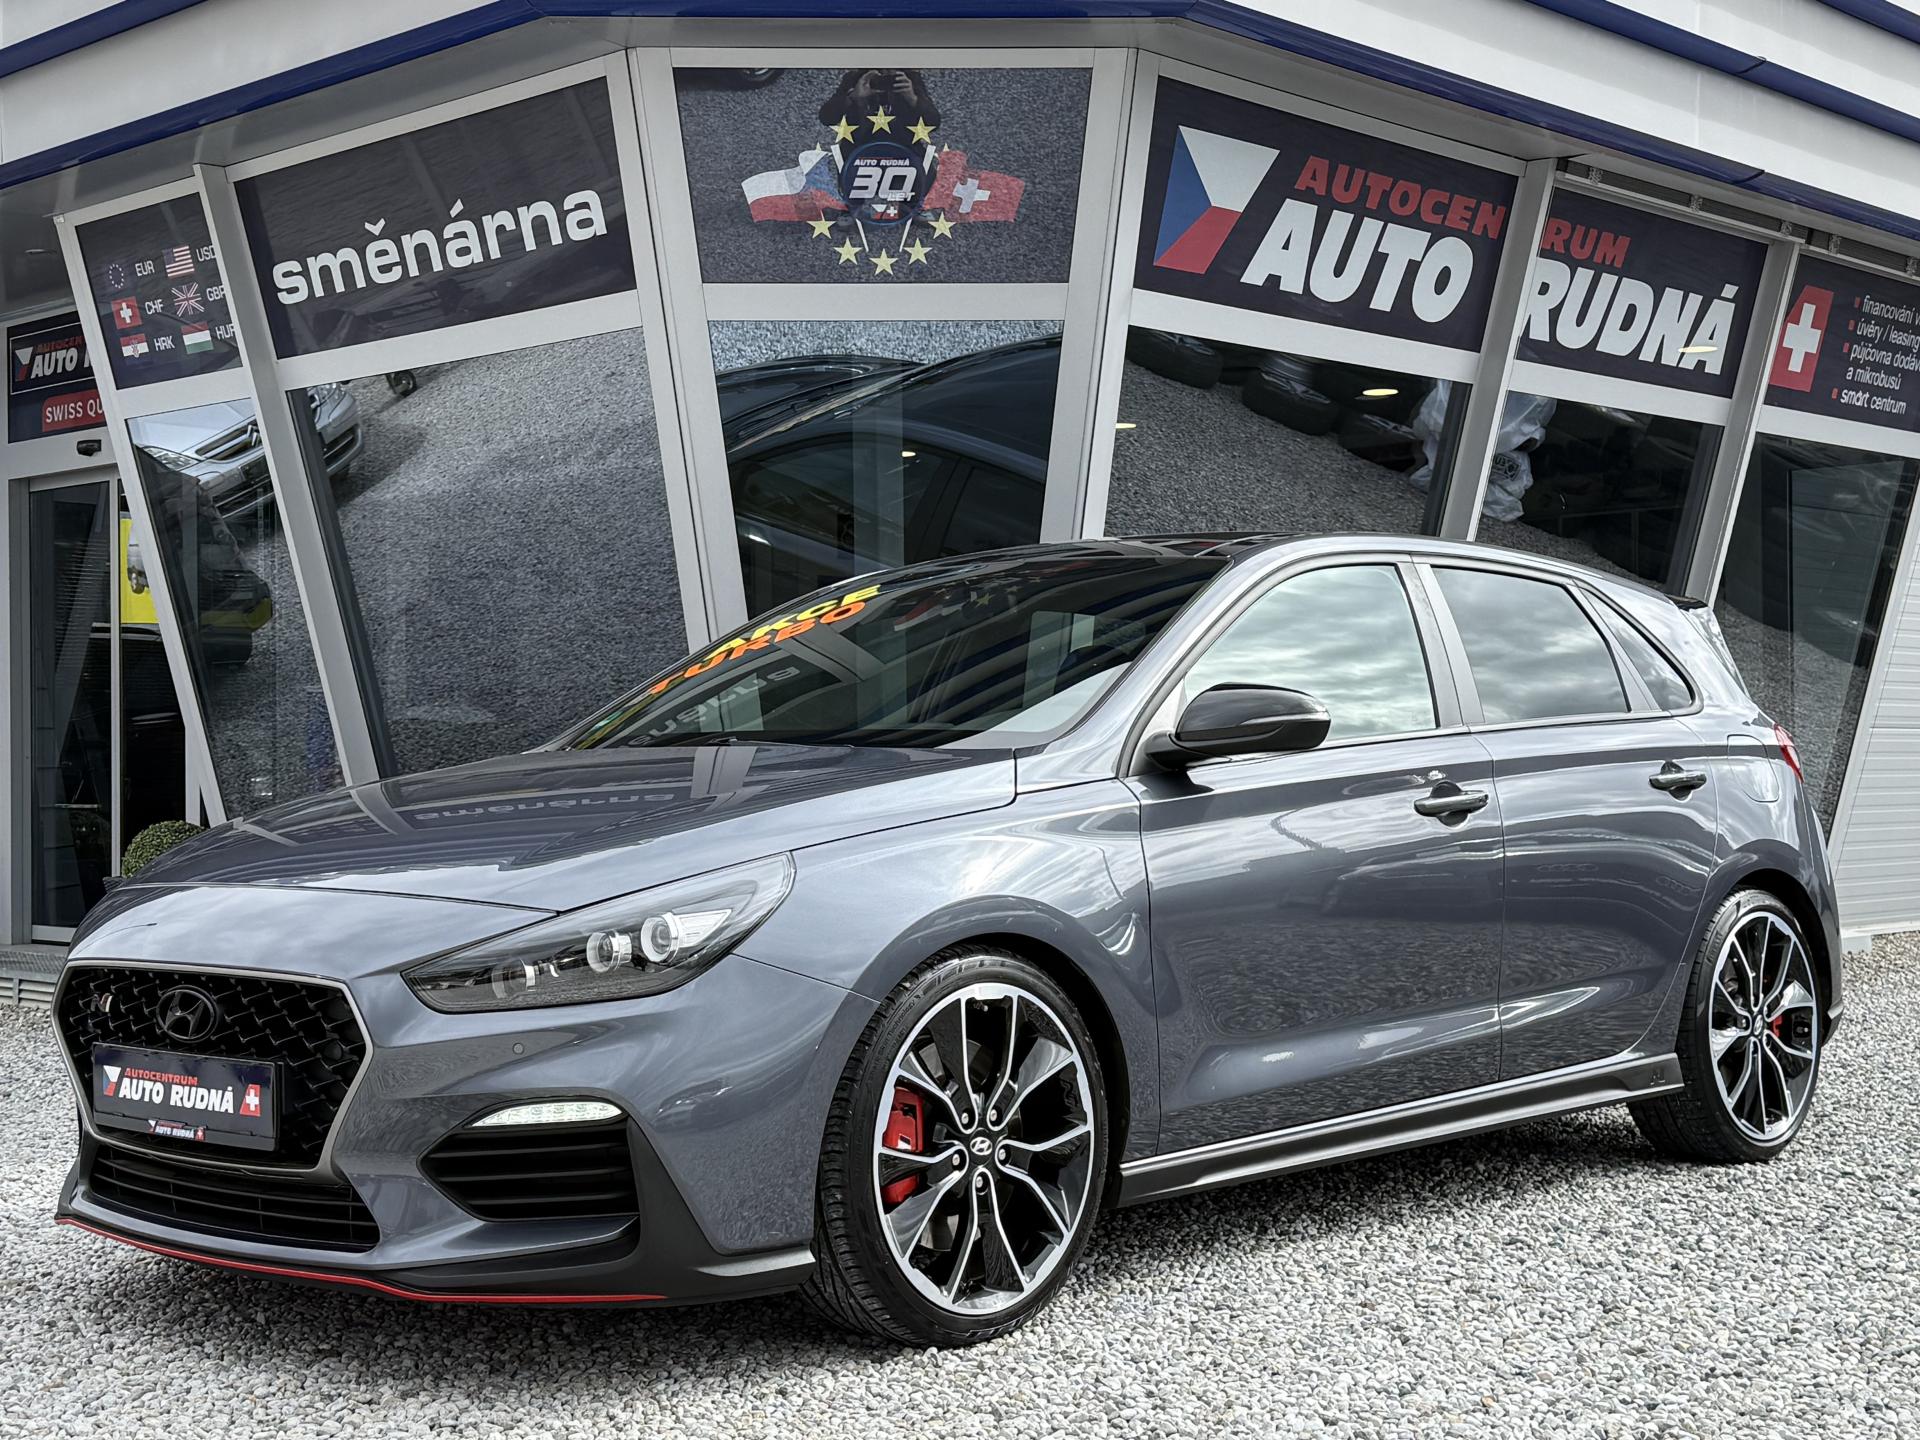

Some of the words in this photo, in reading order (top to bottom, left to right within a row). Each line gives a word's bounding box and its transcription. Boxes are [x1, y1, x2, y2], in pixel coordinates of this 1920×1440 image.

[848, 166, 917, 199] 30
[887, 192, 916, 201] LET
[196, 244, 216, 262] USD
[272, 189, 608, 305] směnárna
[135, 260, 155, 277] EUR
[1239, 198, 1474, 323] AUTO
[1520, 256, 1740, 375] RUDNÁ
[144, 299, 164, 315] CHF
[1862, 295, 1915, 324] financování
[153, 335, 176, 352] HRK
[1856, 318, 1883, 344] úvěry
[1889, 325, 1920, 353] leasing
[30, 347, 78, 379] AUTO
[1850, 341, 1891, 365] půjčovna
[1846, 367, 1854, 381] a
[1854, 366, 1902, 390] mikrobusů
[45, 401, 83, 423] SWISS
[1870, 394, 1906, 415] centrum
[703, 584, 882, 661] AKCE
[650, 601, 866, 695] TURBO
[124, 1067, 199, 1086] AUTOCENTRUM
[118, 1077, 164, 1105] AUTO
[169, 1084, 235, 1114] RUDNÁ
